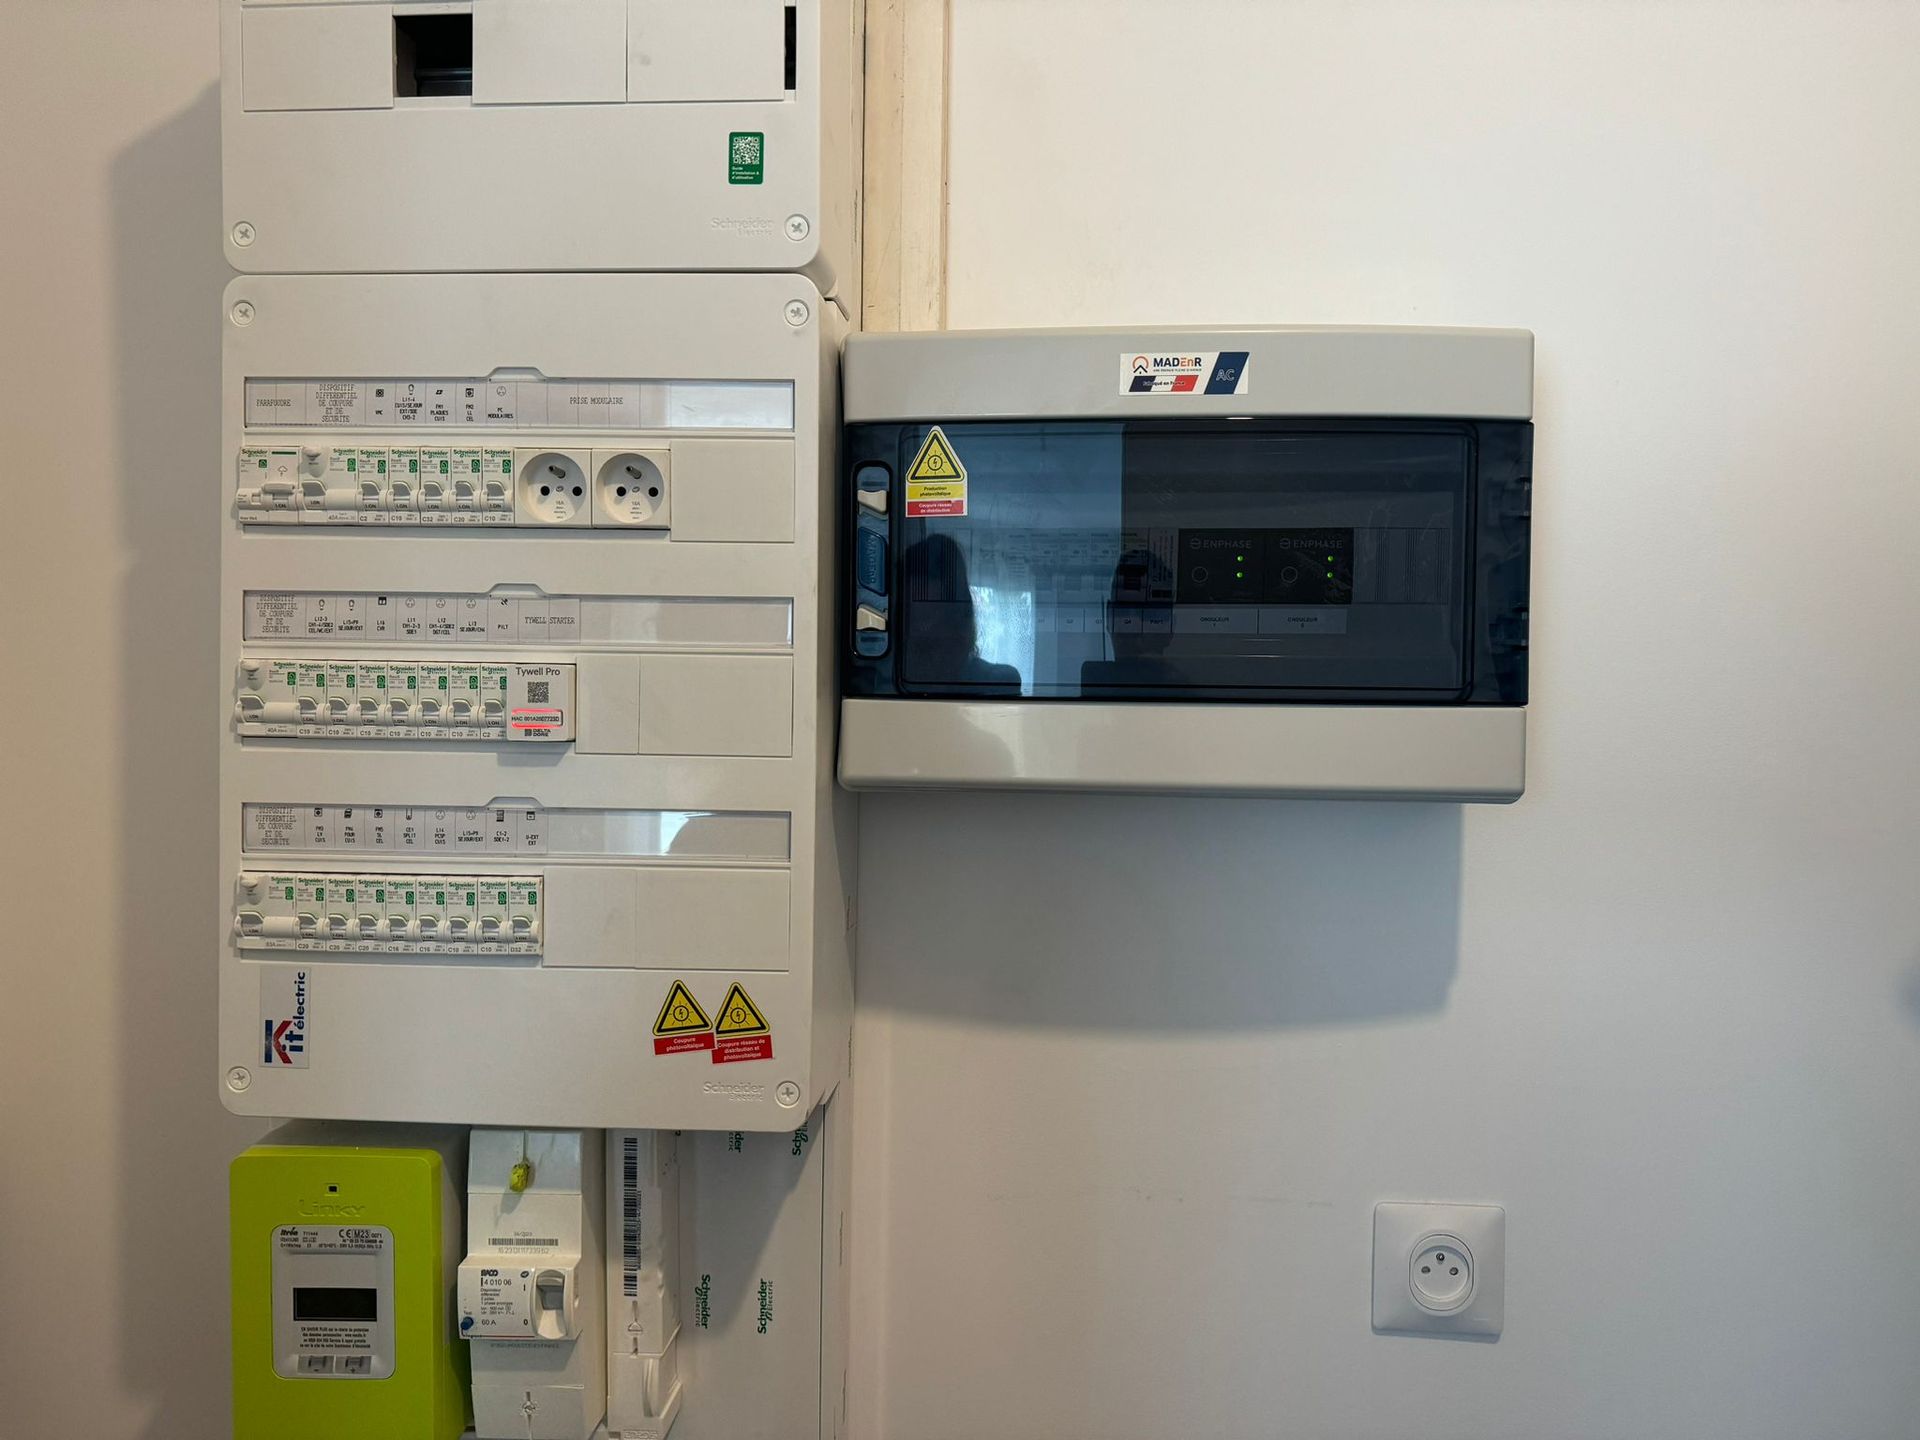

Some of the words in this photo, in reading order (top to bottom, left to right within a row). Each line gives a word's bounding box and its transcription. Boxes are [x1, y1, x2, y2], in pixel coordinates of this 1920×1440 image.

[1216, 368, 1235, 381] AC
[515, 667, 543, 677] Tywell
[546, 667, 560, 675] Pro
[293, 971, 305, 1030] électric
[695, 1274, 711, 1329] Schneider
[757, 1278, 772, 1335] Schneider
